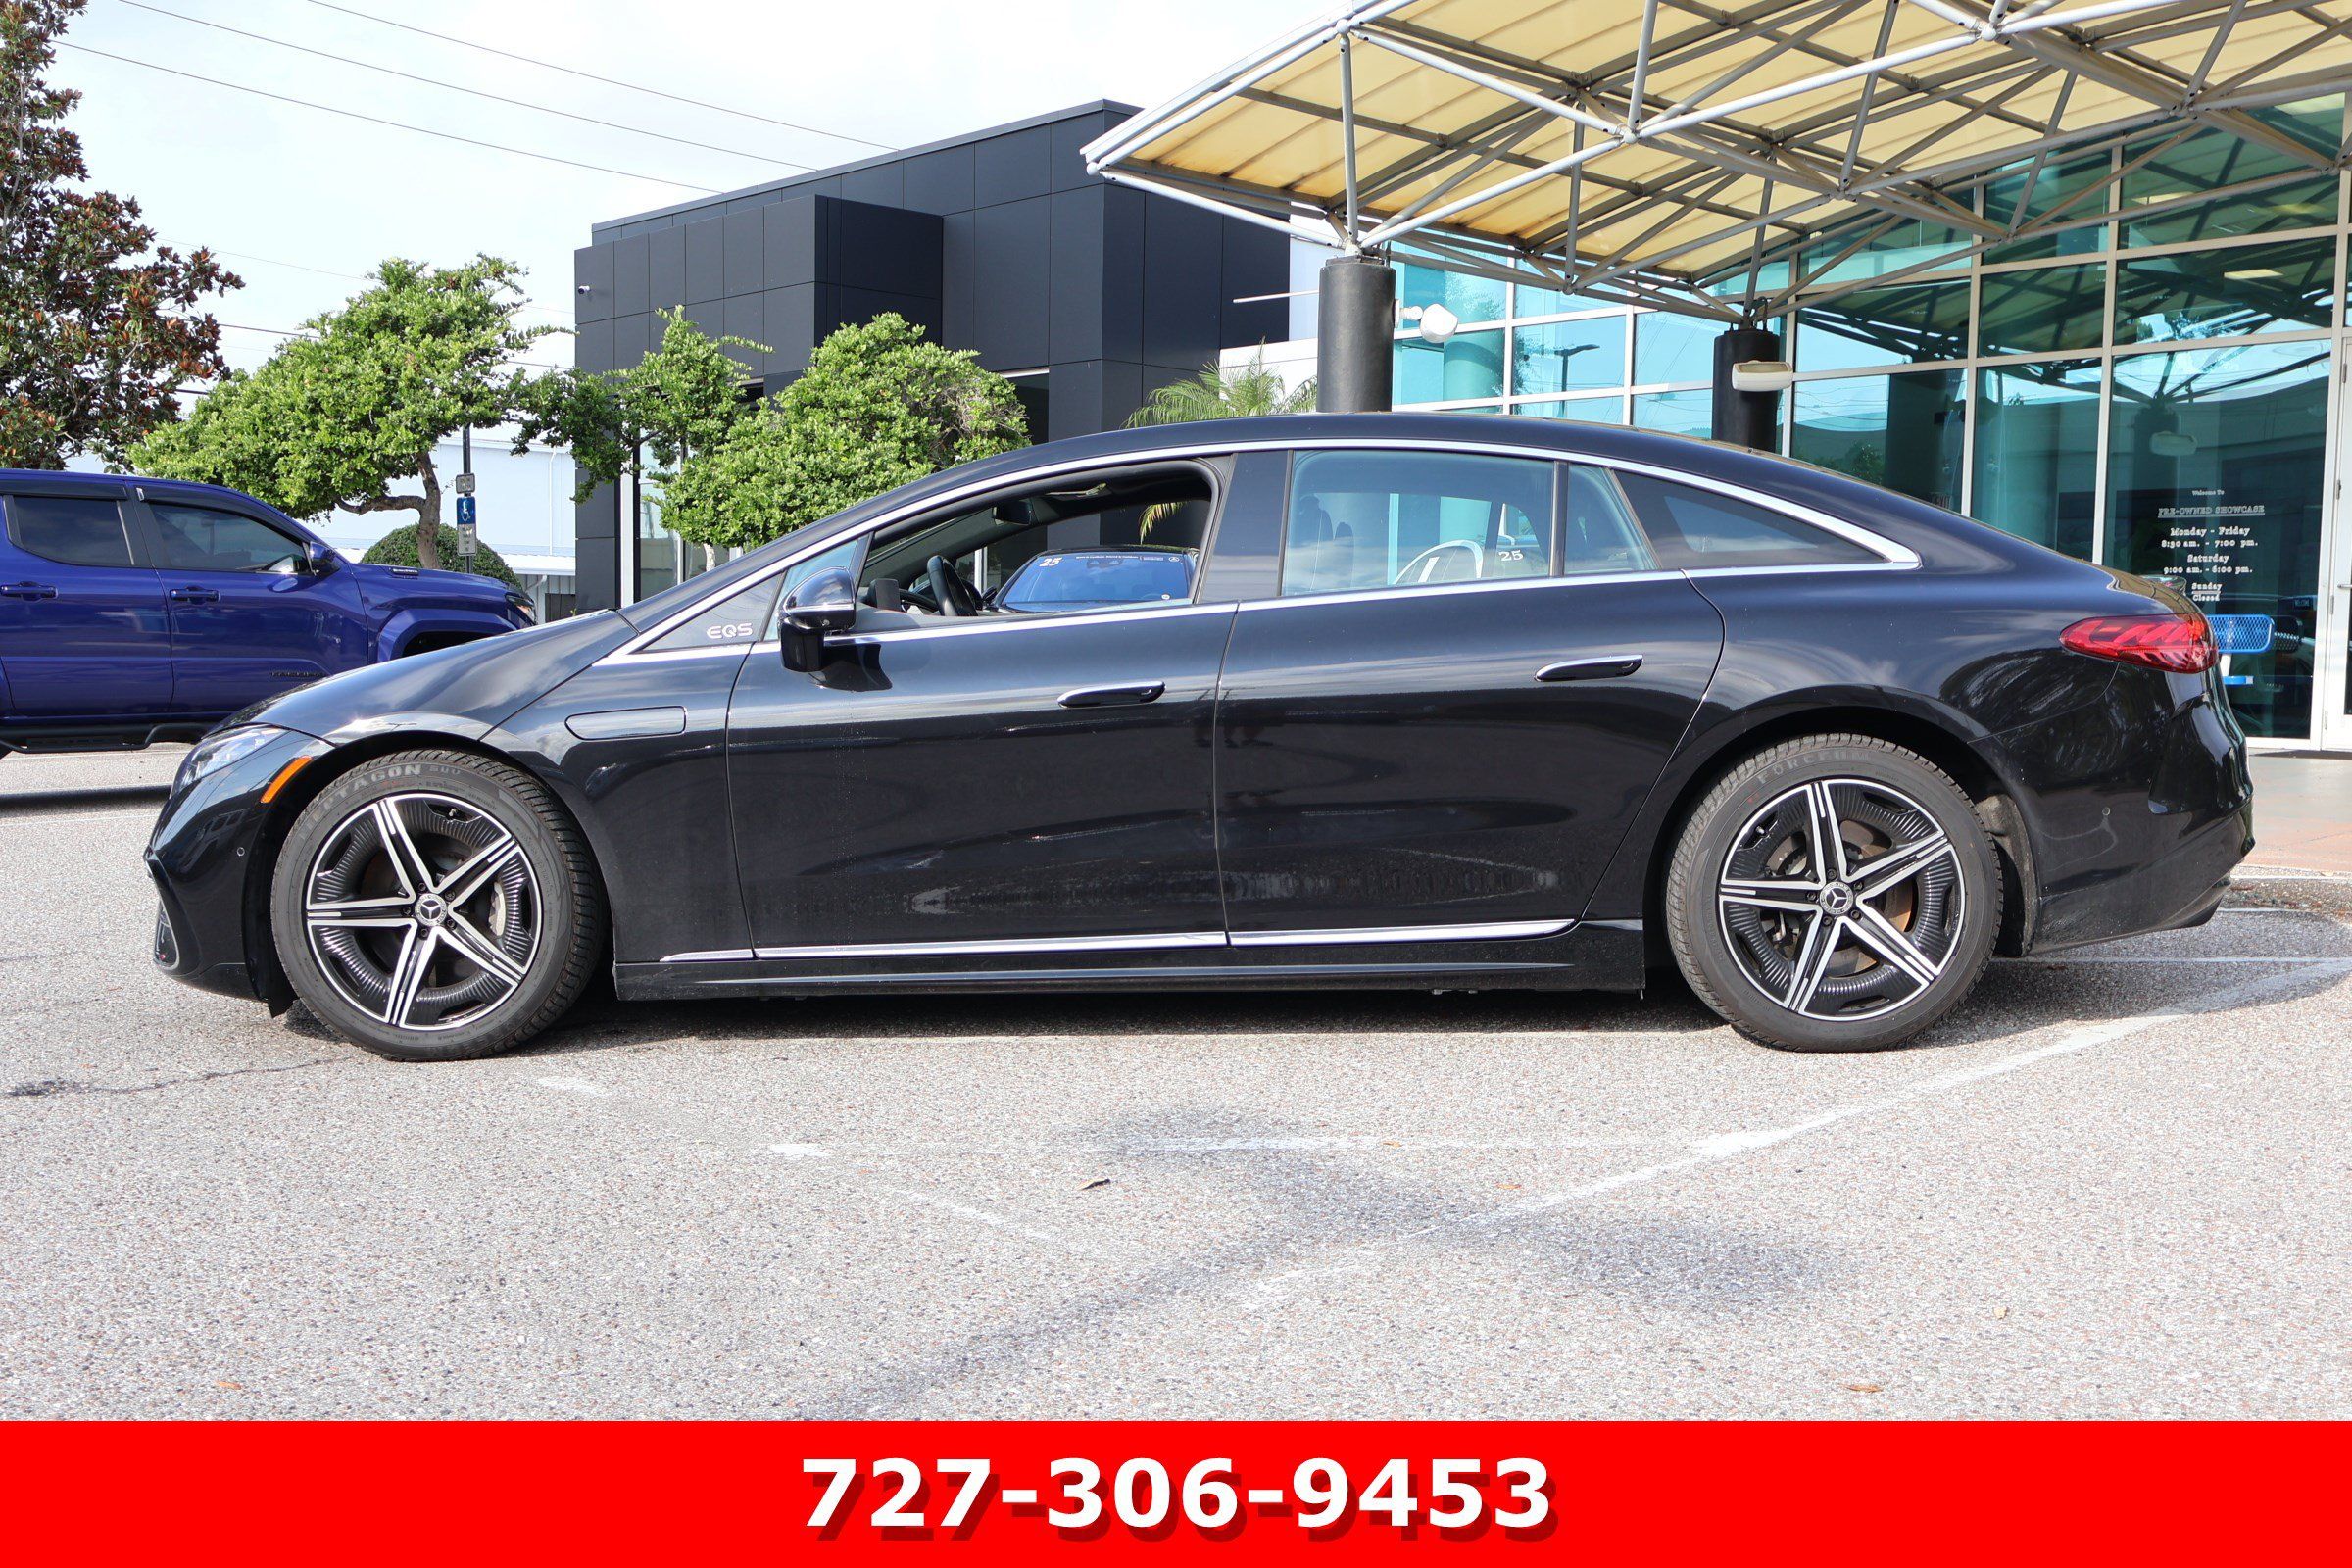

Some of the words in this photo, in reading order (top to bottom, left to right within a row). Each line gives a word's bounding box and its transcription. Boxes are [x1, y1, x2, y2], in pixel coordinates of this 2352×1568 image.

[2158, 506, 2213, 515] PRE-OWNED
[2215, 505, 2265, 514] SHOWCASE
[2170, 526, 2207, 537] Monday
[2219, 525, 2251, 536] Friday
[2161, 539, 2181, 548] 8:30
[2215, 539, 2236, 548] 7:00
[2240, 539, 2258, 548] pm.
[1498, 549, 1524, 562] 25
[2187, 553, 2230, 564] Saturday
[1039, 556, 1064, 567] 25
[2163, 566, 2183, 575] 9:00
[2212, 564, 2232, 573] 6:00
[2235, 565, 2253, 574] pm.
[2191, 582, 2223, 591] Sunday
[2192, 593, 2220, 602] Closed
[706, 622, 753, 639] EQS
